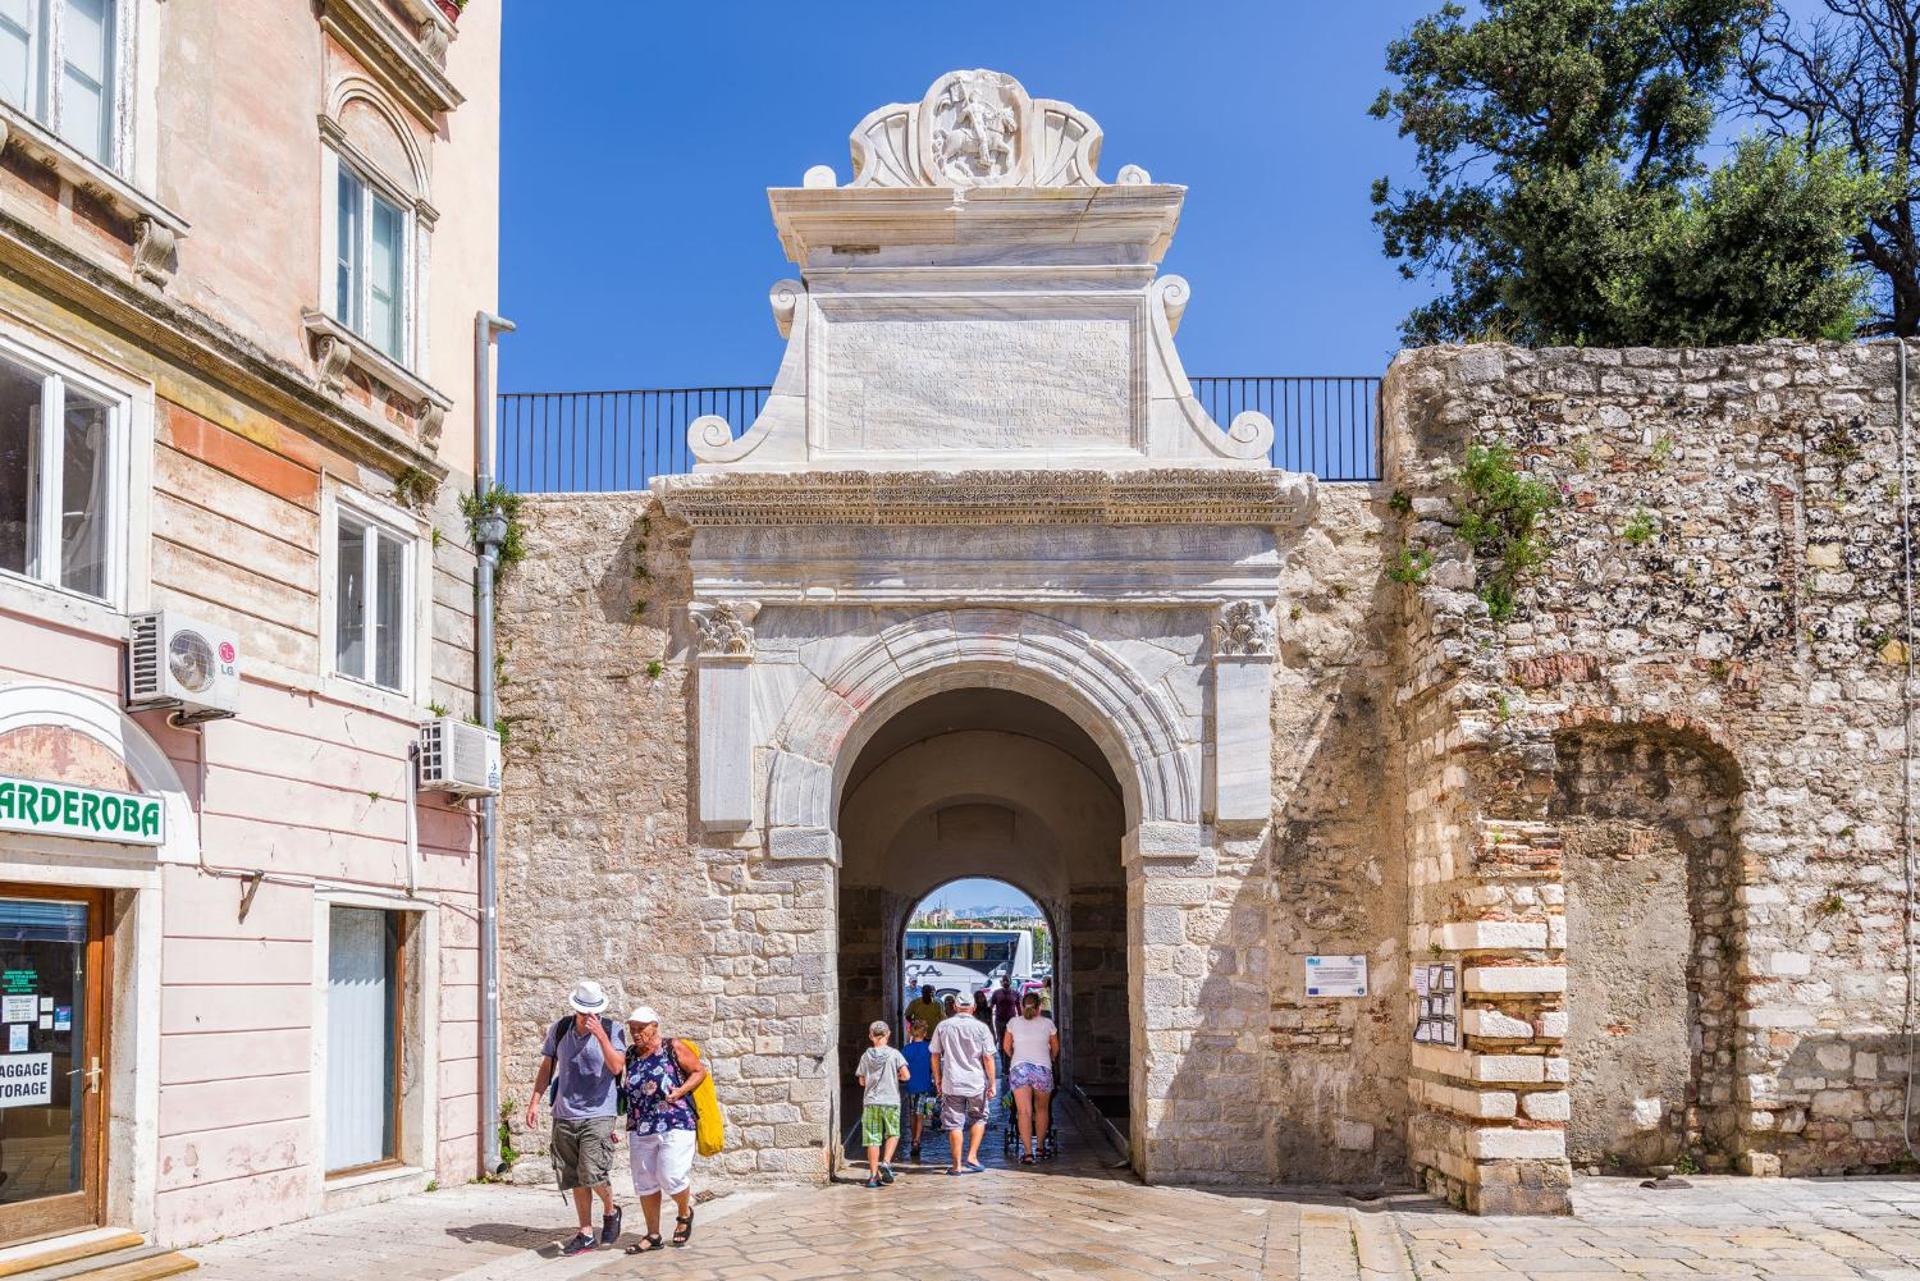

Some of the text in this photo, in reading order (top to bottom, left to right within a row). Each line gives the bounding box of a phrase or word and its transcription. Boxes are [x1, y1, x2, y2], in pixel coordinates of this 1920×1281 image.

[220, 663, 235, 676] LG
[0, 781, 160, 838] ARDEROBA
[0, 1062, 48, 1079] AGGAGE
